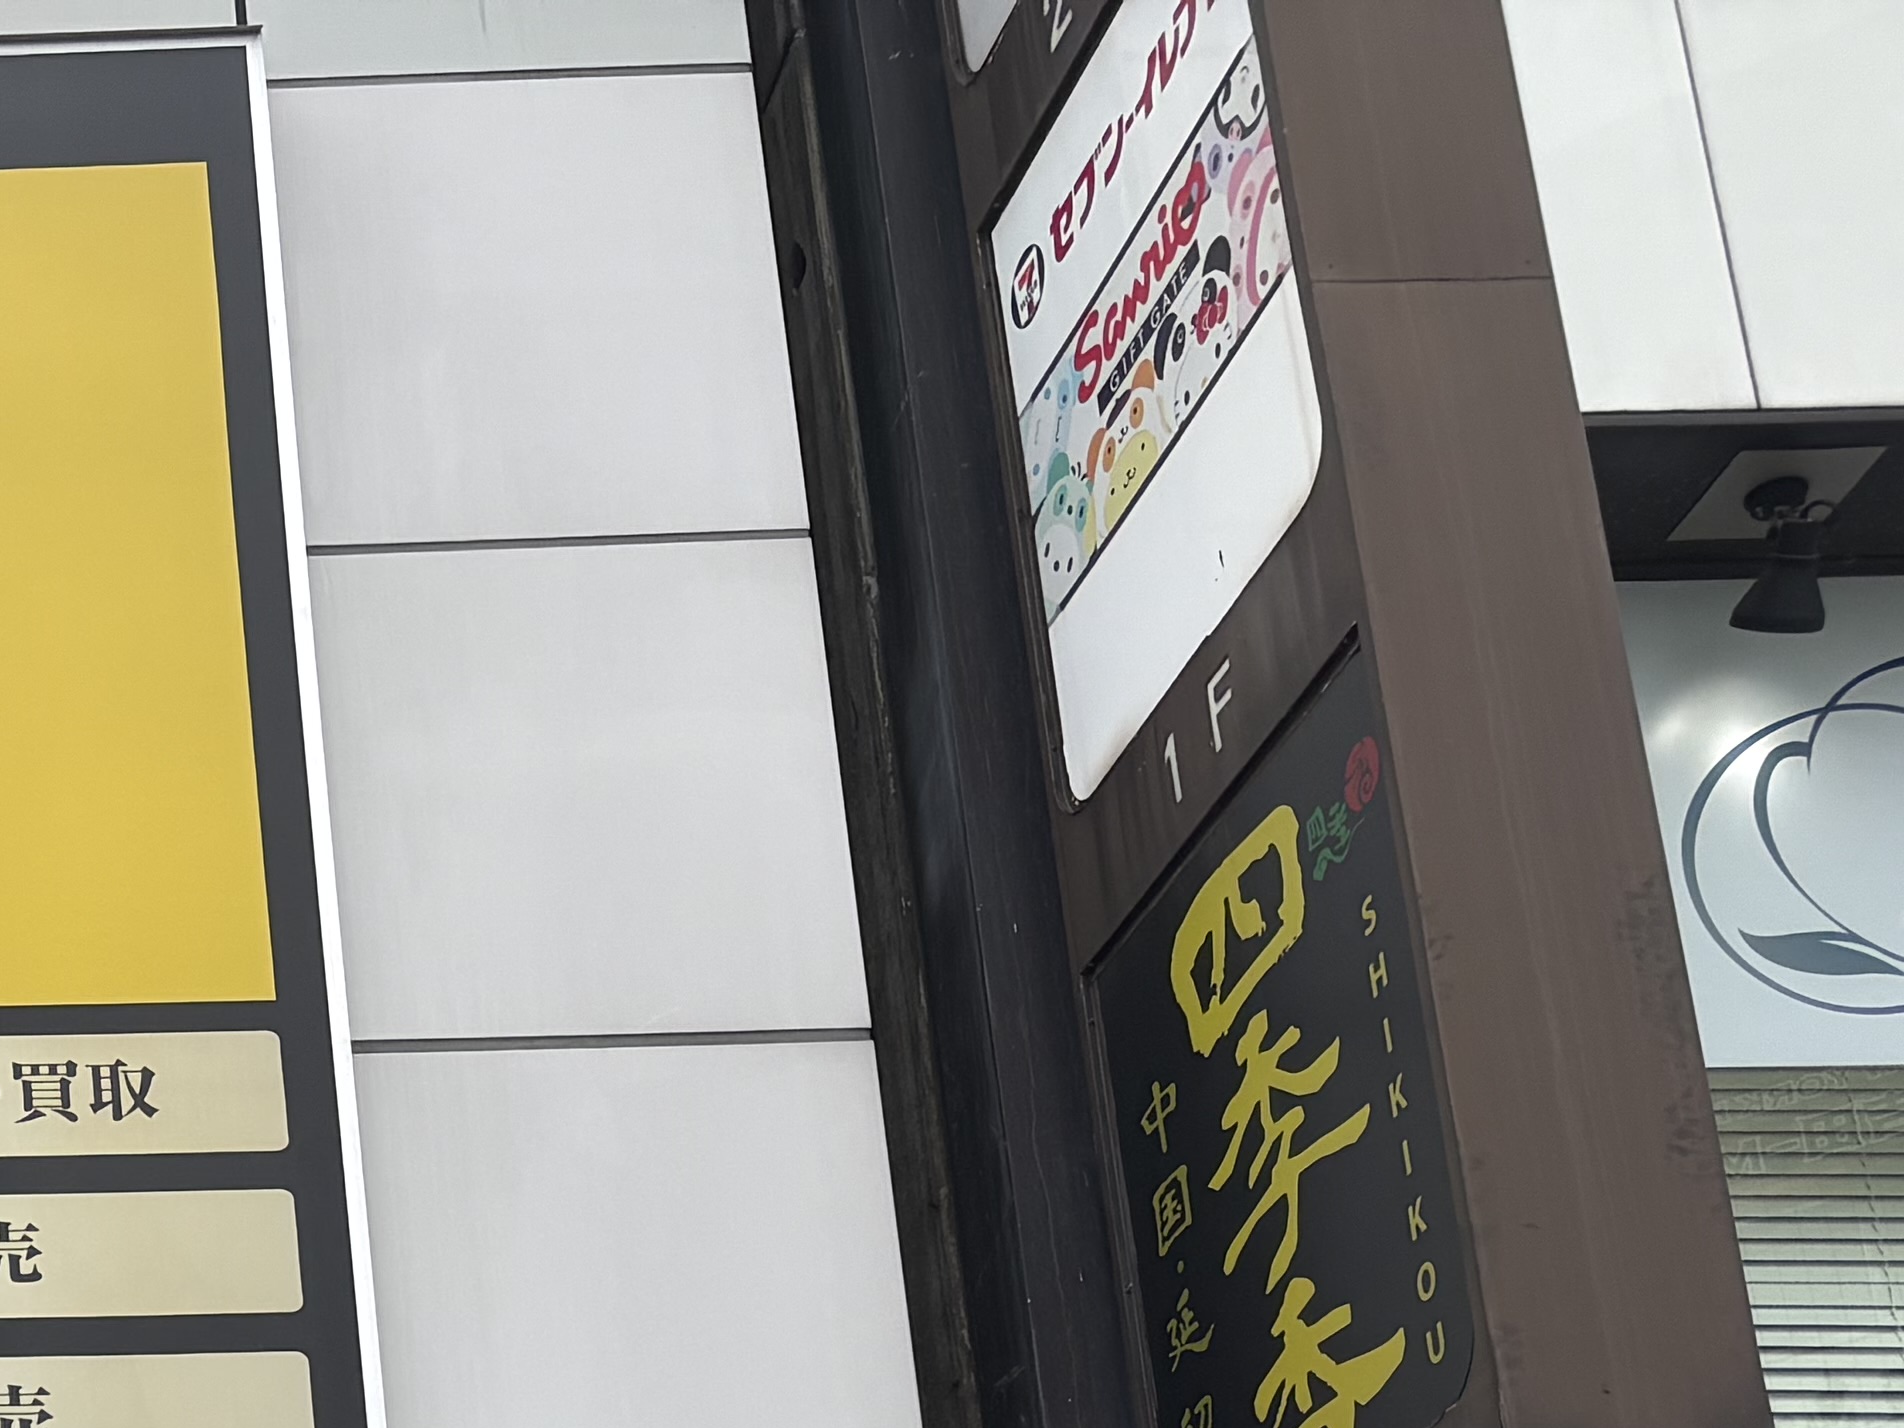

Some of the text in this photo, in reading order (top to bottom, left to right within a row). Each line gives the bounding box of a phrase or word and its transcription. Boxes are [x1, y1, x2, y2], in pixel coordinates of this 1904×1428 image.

[1073, 159, 1208, 405] Sanrio
[1110, 261, 1189, 392] GIFT GATE
[1163, 660, 1231, 804] 1F
[1360, 894, 1445, 1366] SHIKIKOU
